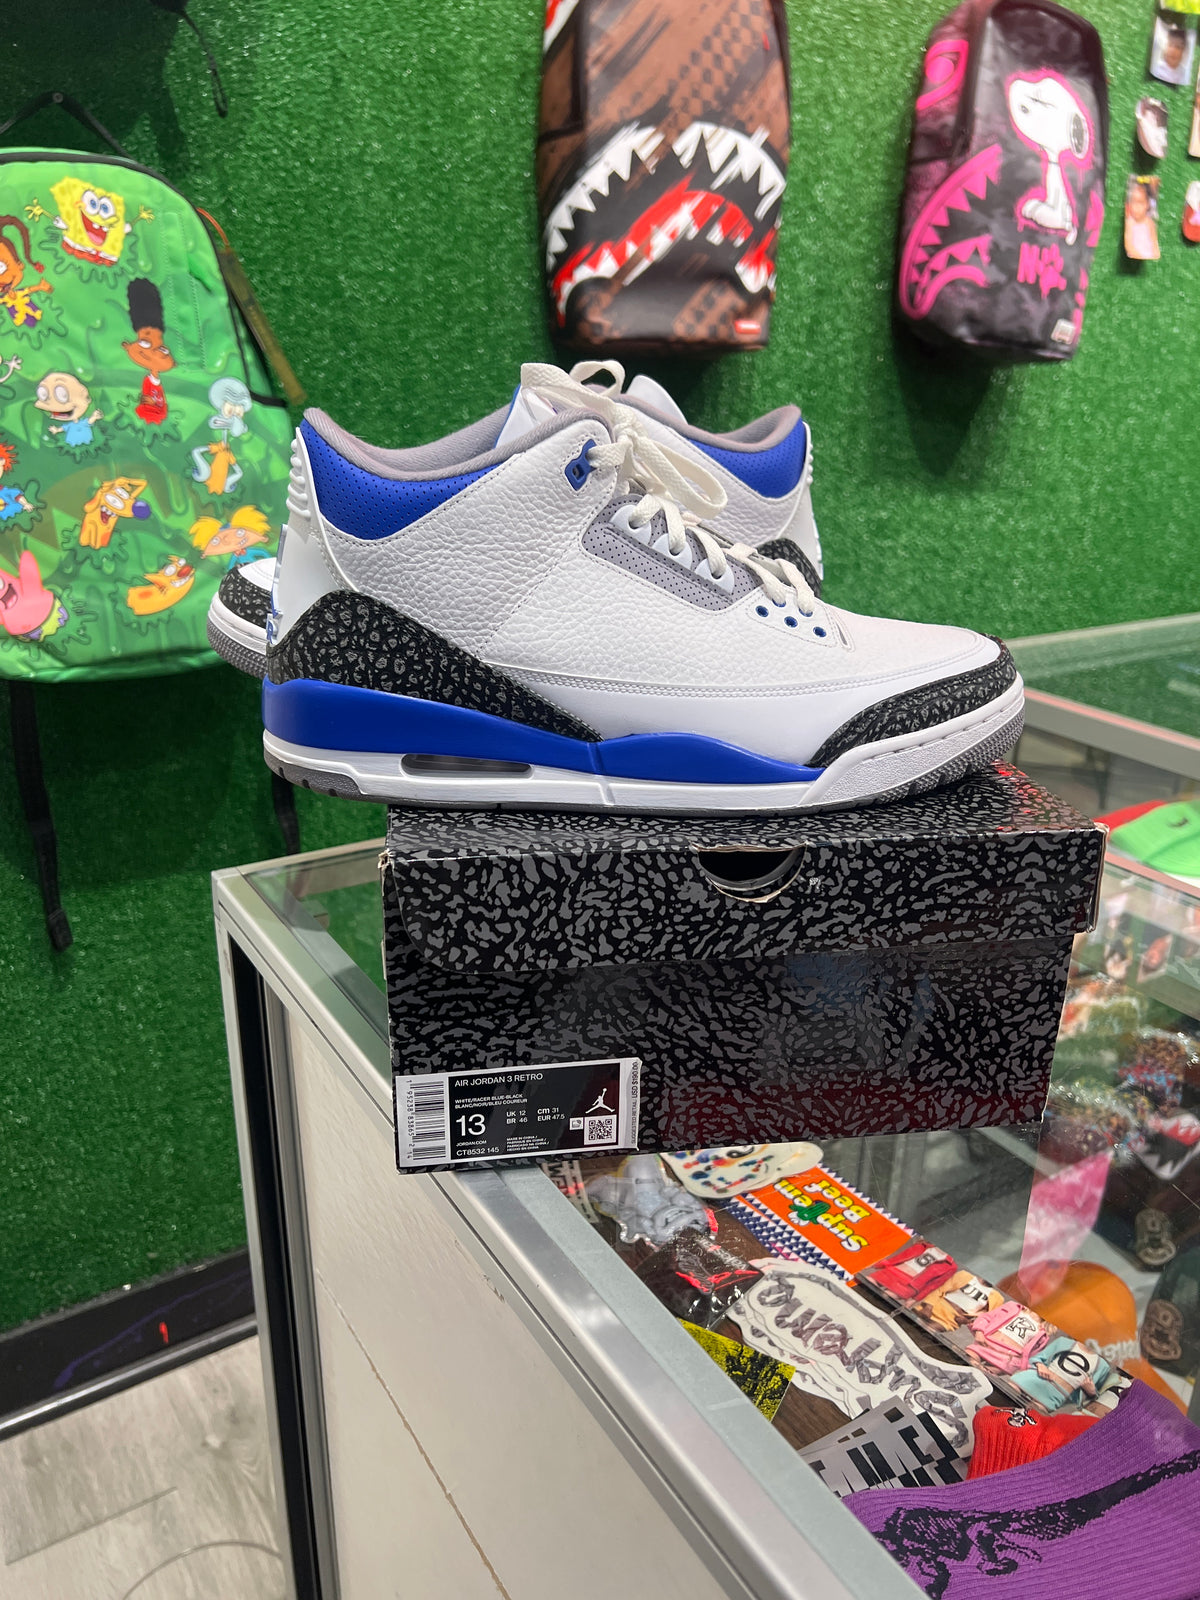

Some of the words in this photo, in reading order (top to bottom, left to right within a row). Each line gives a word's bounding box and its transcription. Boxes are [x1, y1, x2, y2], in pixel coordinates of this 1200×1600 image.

[454, 1079, 469, 1088] AIR
[470, 1076, 505, 1086] JORDAN
[514, 1073, 543, 1082] RETRO
[455, 1096, 491, 1104] WHITE/RACER
[455, 1113, 486, 1136] 13
[456, 1147, 486, 1156] CT8532
[803, 1179, 871, 1224] Beef
[961, 1283, 988, 1301] UP
